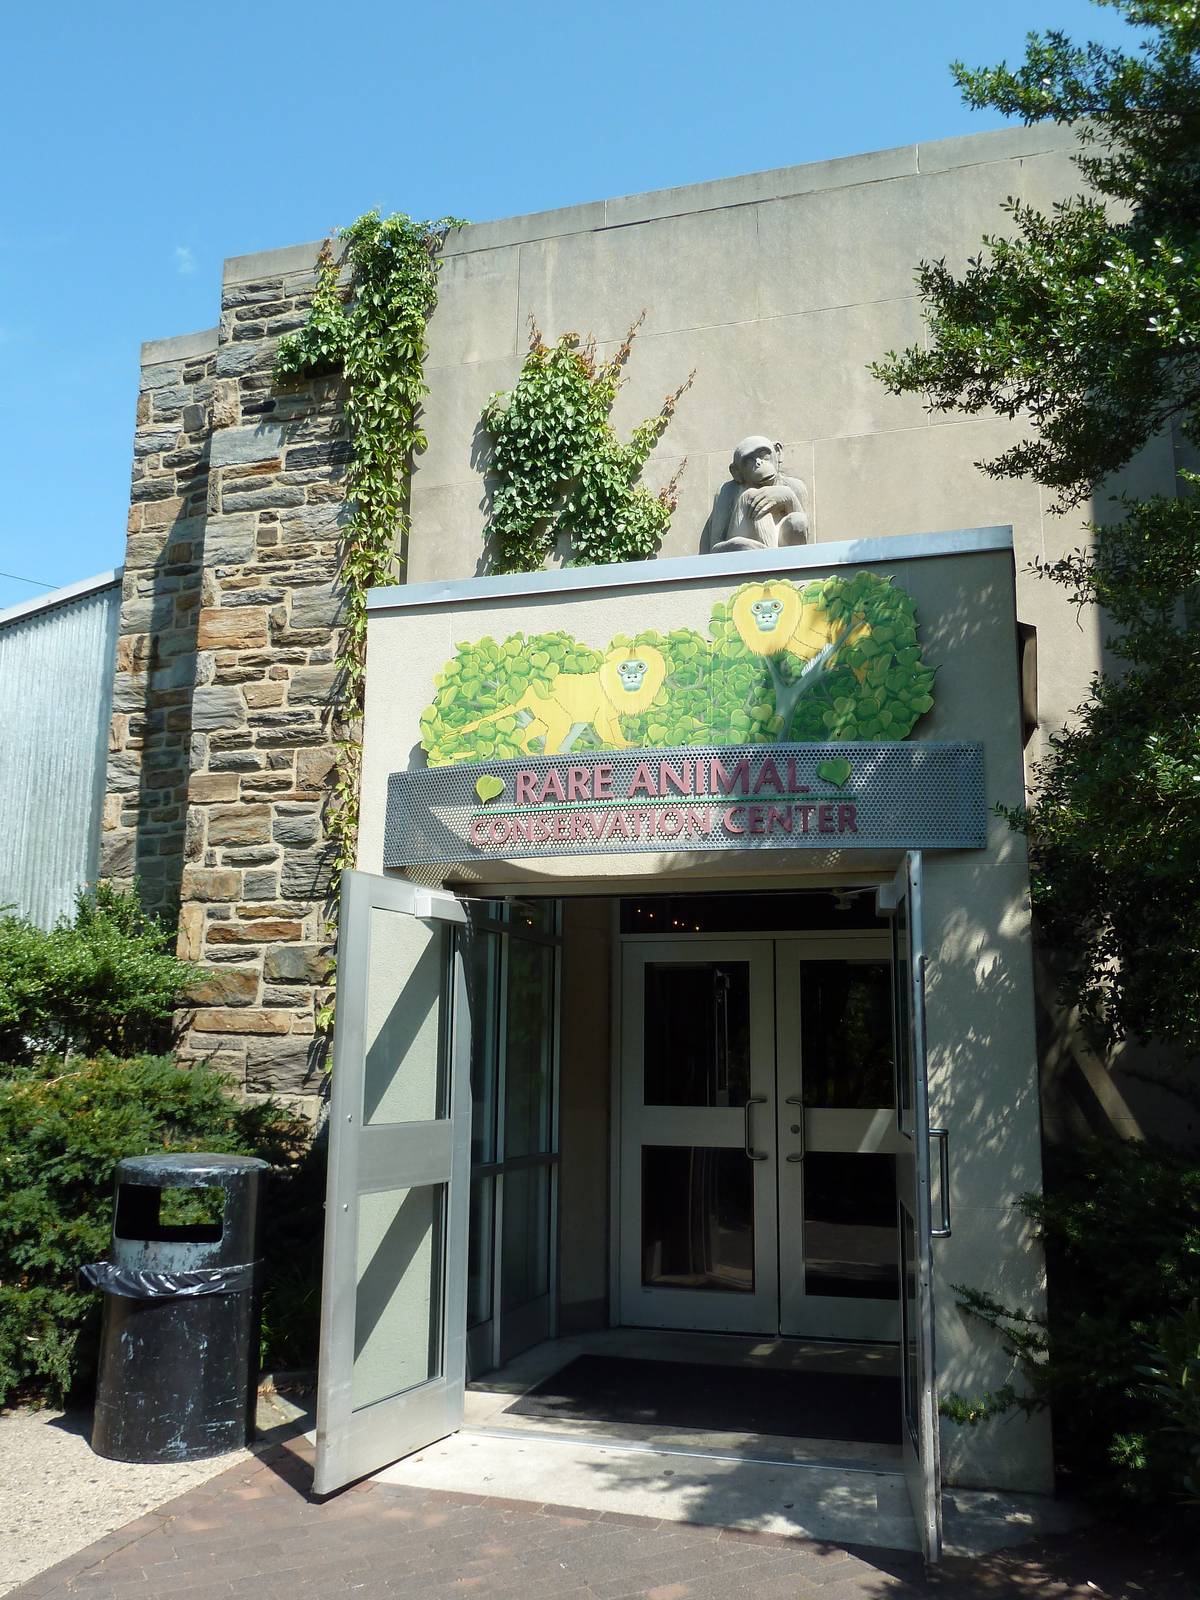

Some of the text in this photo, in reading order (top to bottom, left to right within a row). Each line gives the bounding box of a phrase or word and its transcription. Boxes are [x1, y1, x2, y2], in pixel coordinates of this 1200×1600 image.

[516, 757, 809, 804] RARE ANIMAL
[469, 803, 858, 845] CONSERVATION CENTER
